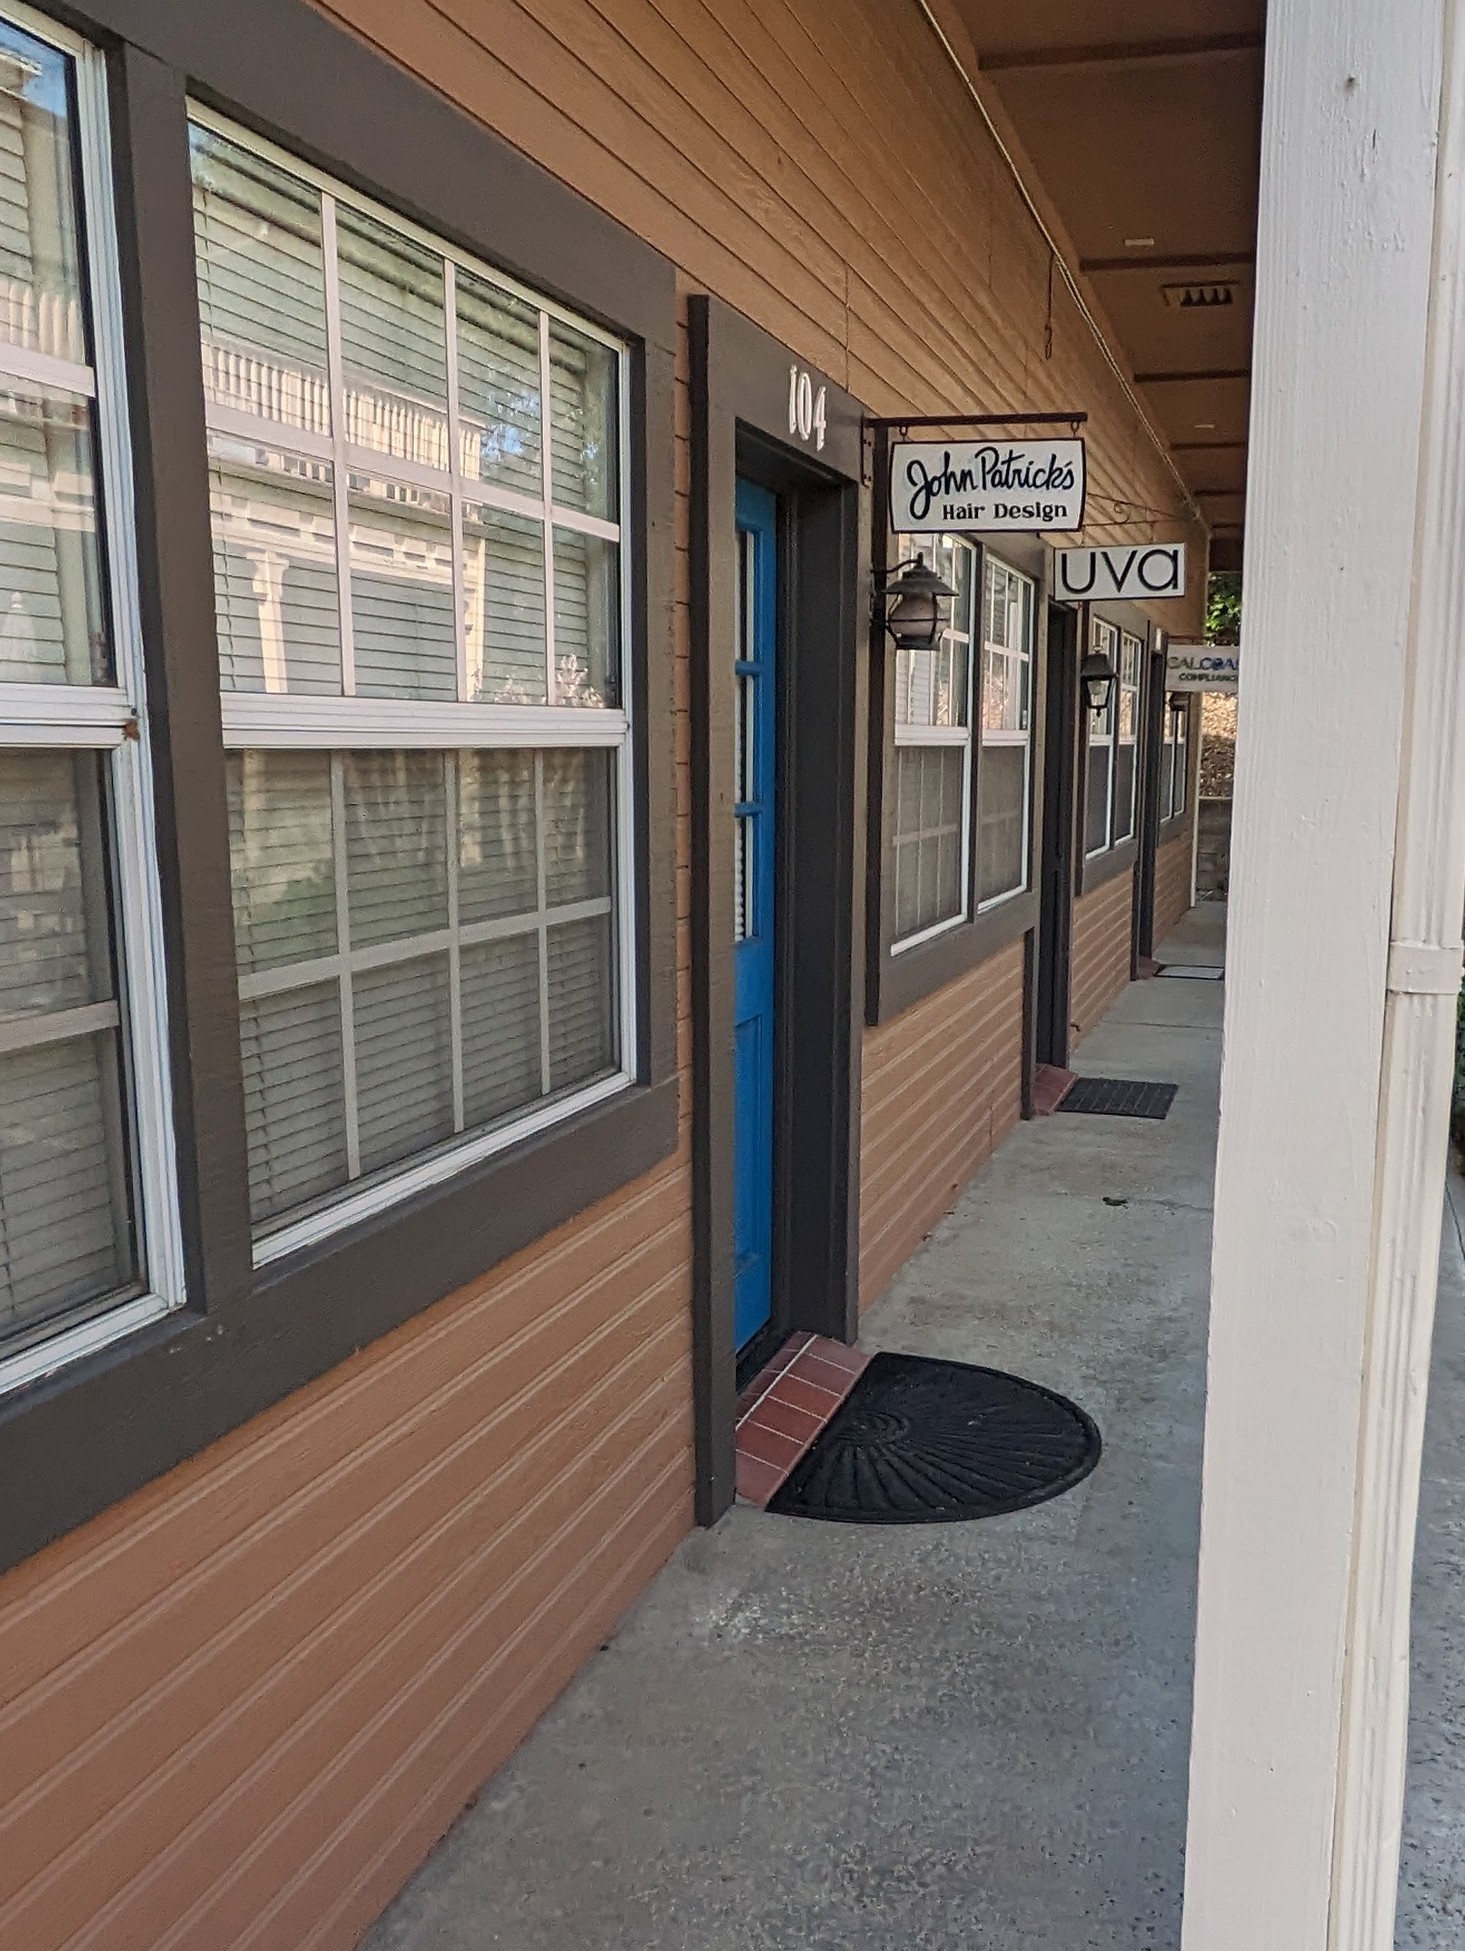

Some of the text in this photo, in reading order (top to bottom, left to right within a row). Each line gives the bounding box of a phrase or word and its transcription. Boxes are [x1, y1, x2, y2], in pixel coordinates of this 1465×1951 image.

[789, 365, 826, 451] 104
[906, 446, 1075, 520] John Patrick's
[942, 501, 1067, 521] Hair Design
